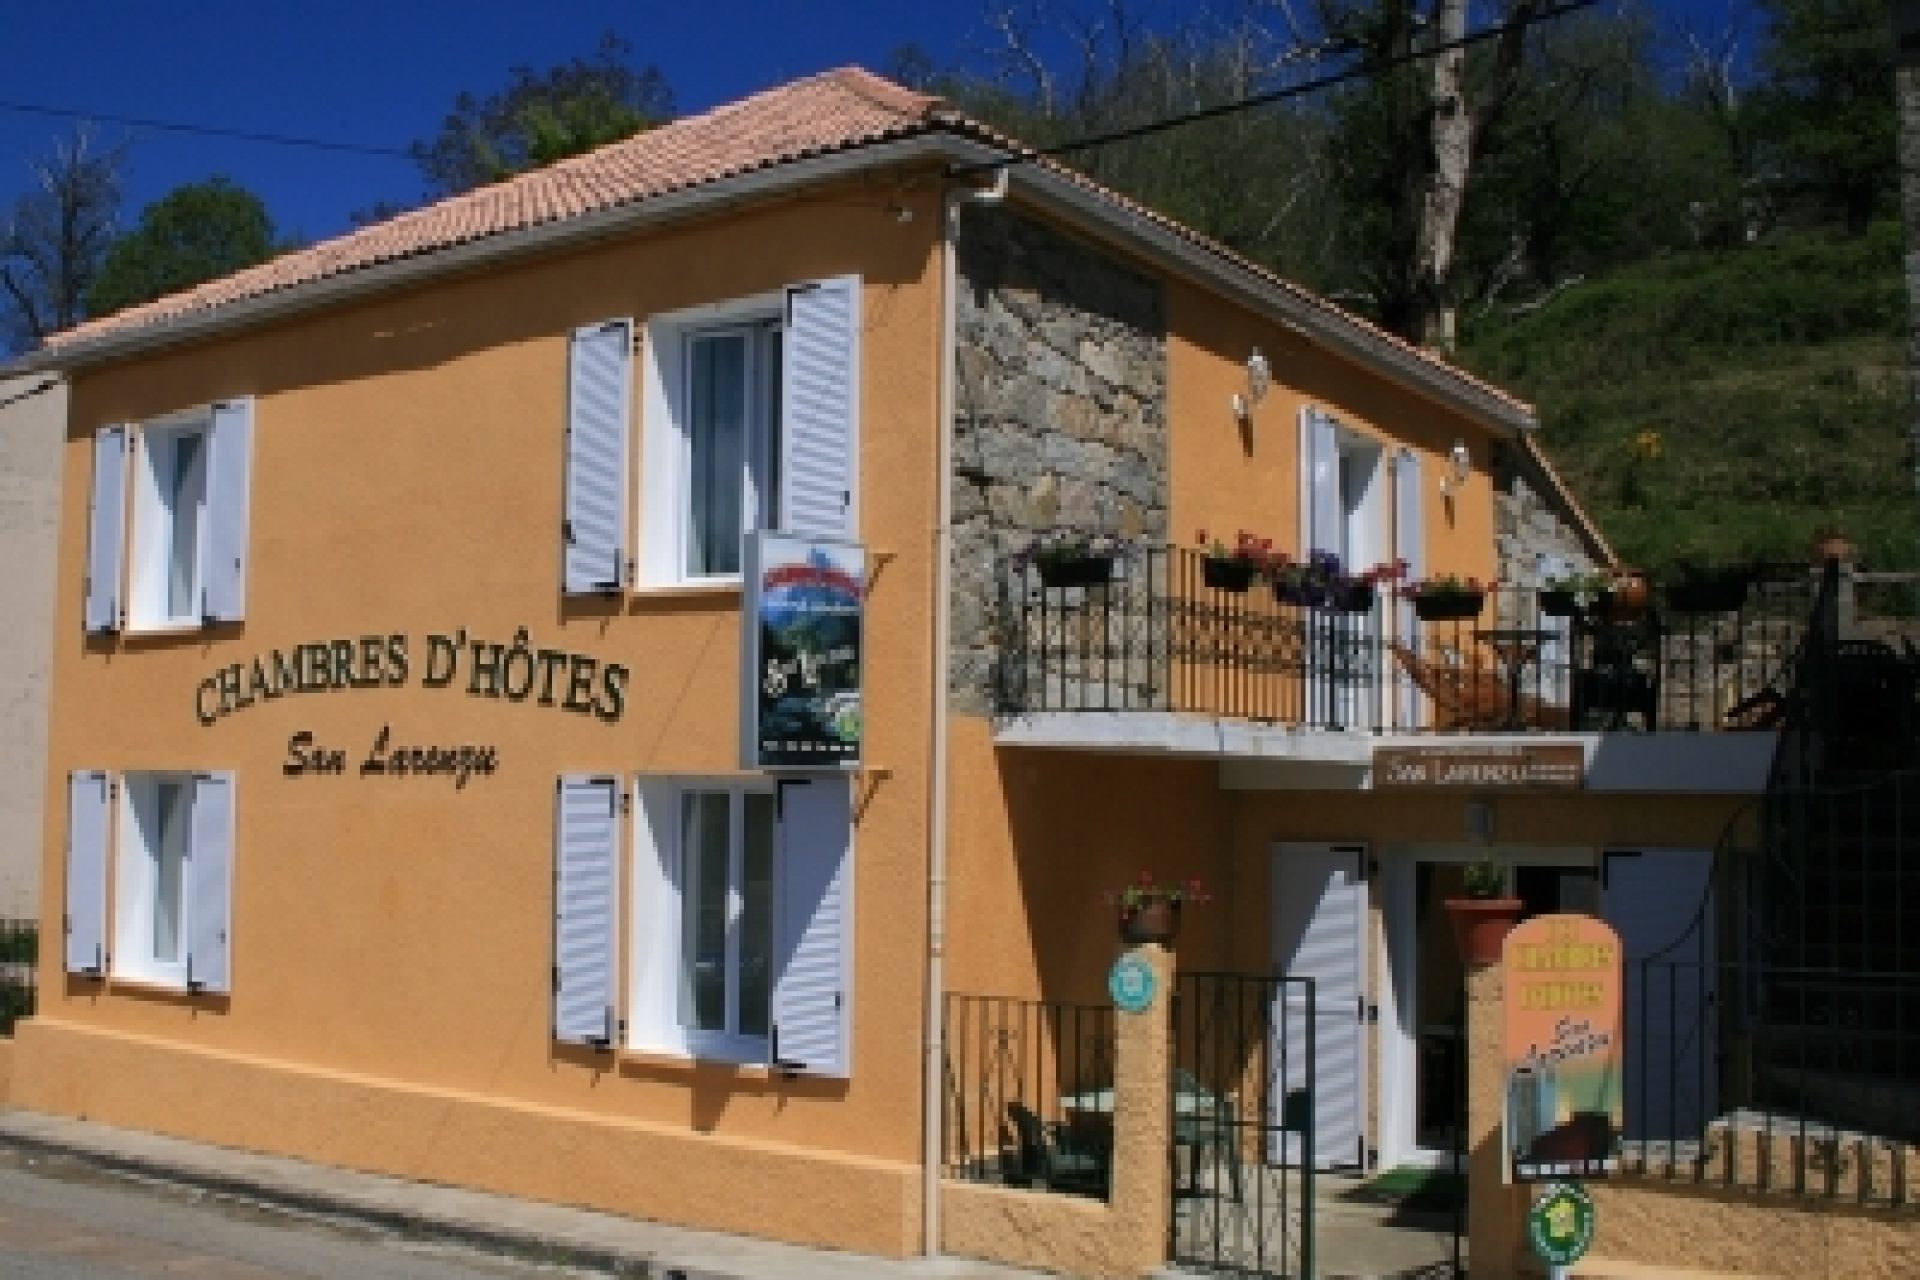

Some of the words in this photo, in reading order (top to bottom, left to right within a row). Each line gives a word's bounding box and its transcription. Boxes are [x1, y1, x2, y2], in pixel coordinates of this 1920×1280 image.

[196, 634, 409, 726] CHAMBRES
[422, 626, 630, 725] D'HÔTES
[283, 730, 347, 777] San
